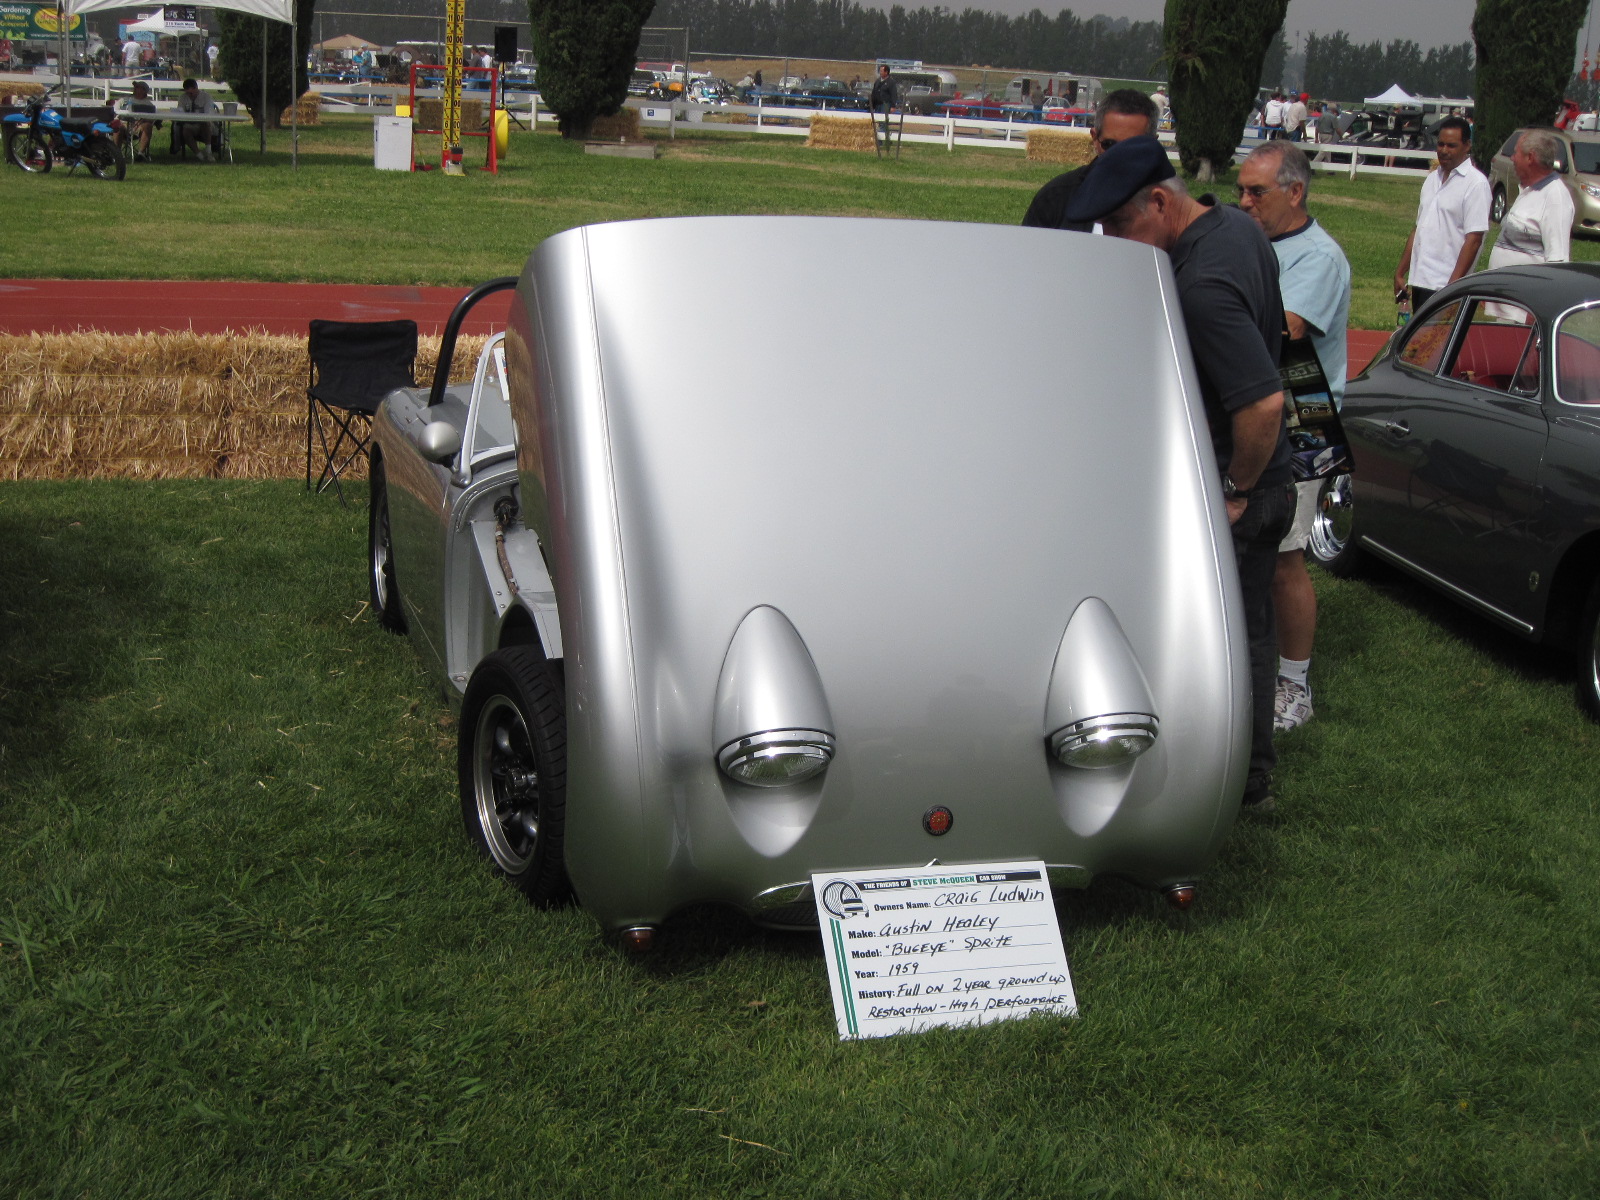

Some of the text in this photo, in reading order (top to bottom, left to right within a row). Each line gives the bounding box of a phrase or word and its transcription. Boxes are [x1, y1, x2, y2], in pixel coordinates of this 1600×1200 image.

[876, 881, 900, 889] FRIENDS
[912, 878, 938, 886] STEVE
[939, 875, 975, 885] McQUEEN
[874, 902, 905, 911] Owners
[906, 900, 931, 909] Name:
[848, 930, 877, 939] Make:
[851, 949, 882, 959] Model:
[855, 962, 920, 979] Year: 1959
[858, 990, 895, 999] History:
[897, 983, 921, 997] Full
[952, 977, 962, 992] 2
